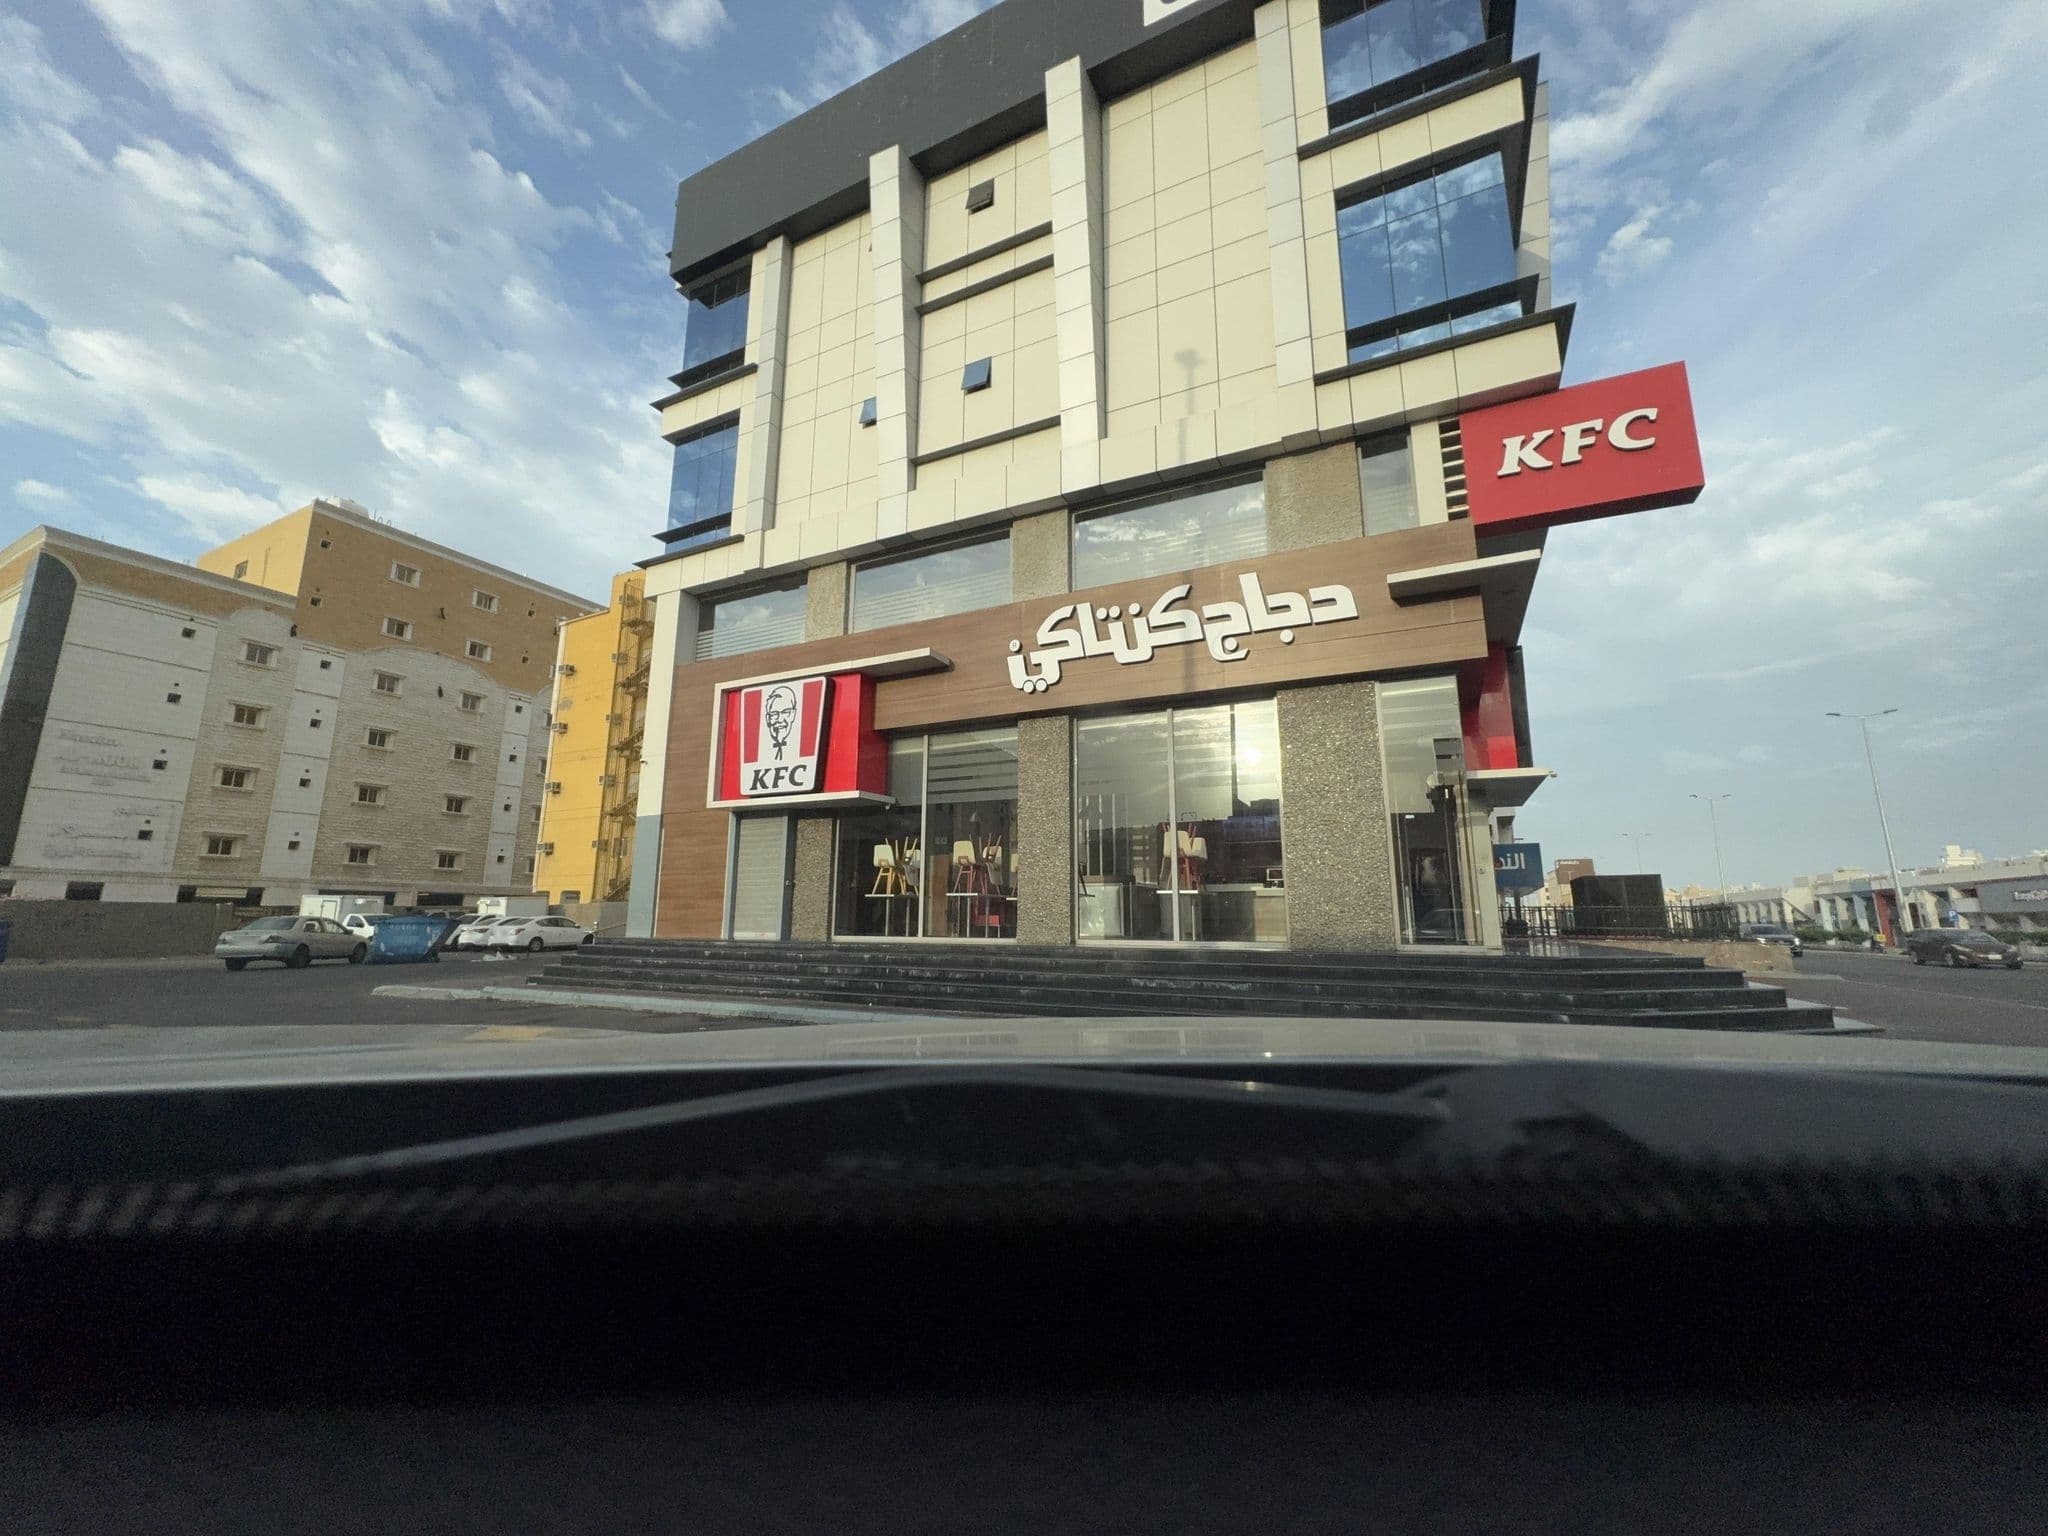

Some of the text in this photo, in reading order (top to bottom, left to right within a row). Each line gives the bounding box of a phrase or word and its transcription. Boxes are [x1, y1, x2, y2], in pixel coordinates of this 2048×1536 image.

[1496, 407, 1658, 478] KFC
[1007, 571, 1359, 693] دجاج كنتاكي
[749, 764, 807, 791] KFC
